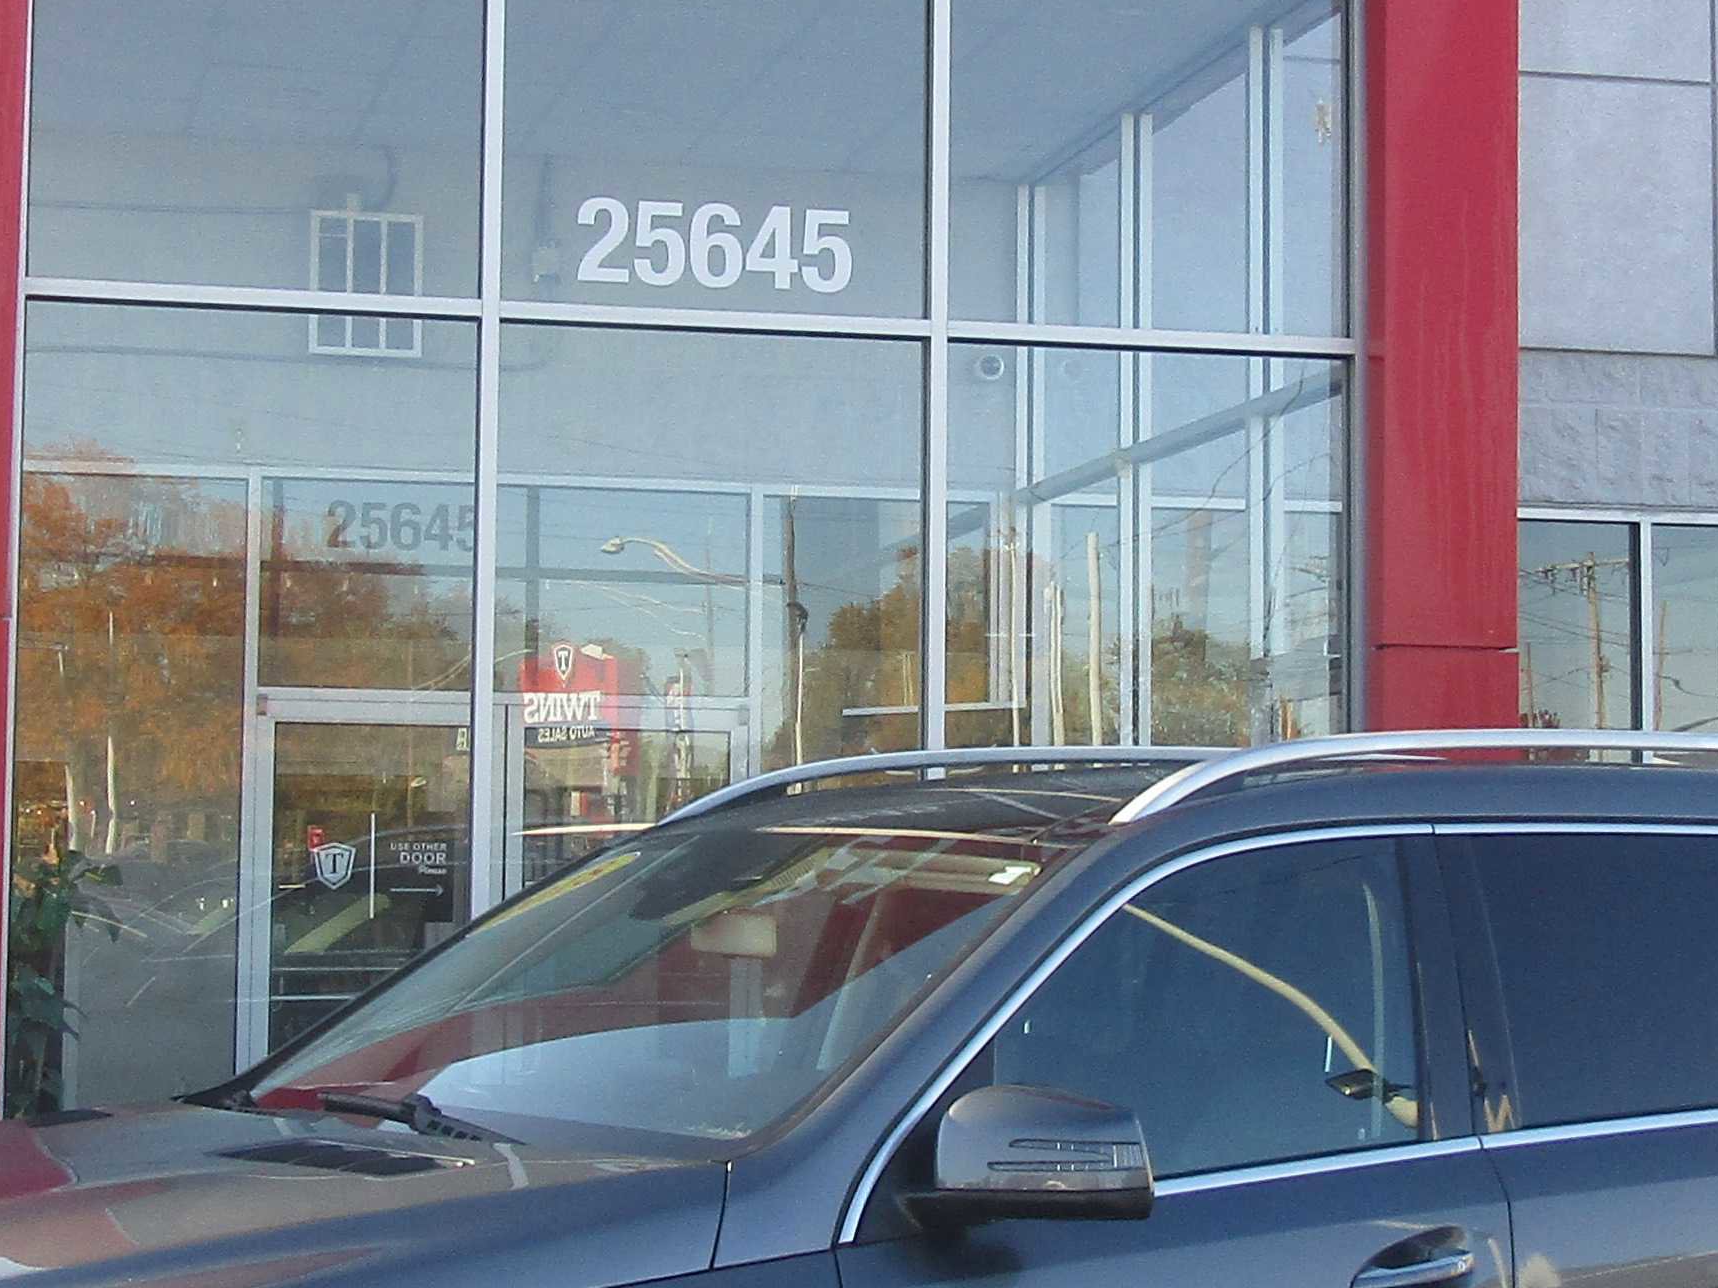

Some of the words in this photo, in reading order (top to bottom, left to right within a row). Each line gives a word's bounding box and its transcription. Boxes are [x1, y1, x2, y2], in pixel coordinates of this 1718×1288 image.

[577, 196, 853, 294] 25645
[390, 842, 409, 851] USE
[412, 842, 447, 851] OTHER
[325, 853, 344, 874] T
[400, 852, 446, 864] DOOR
